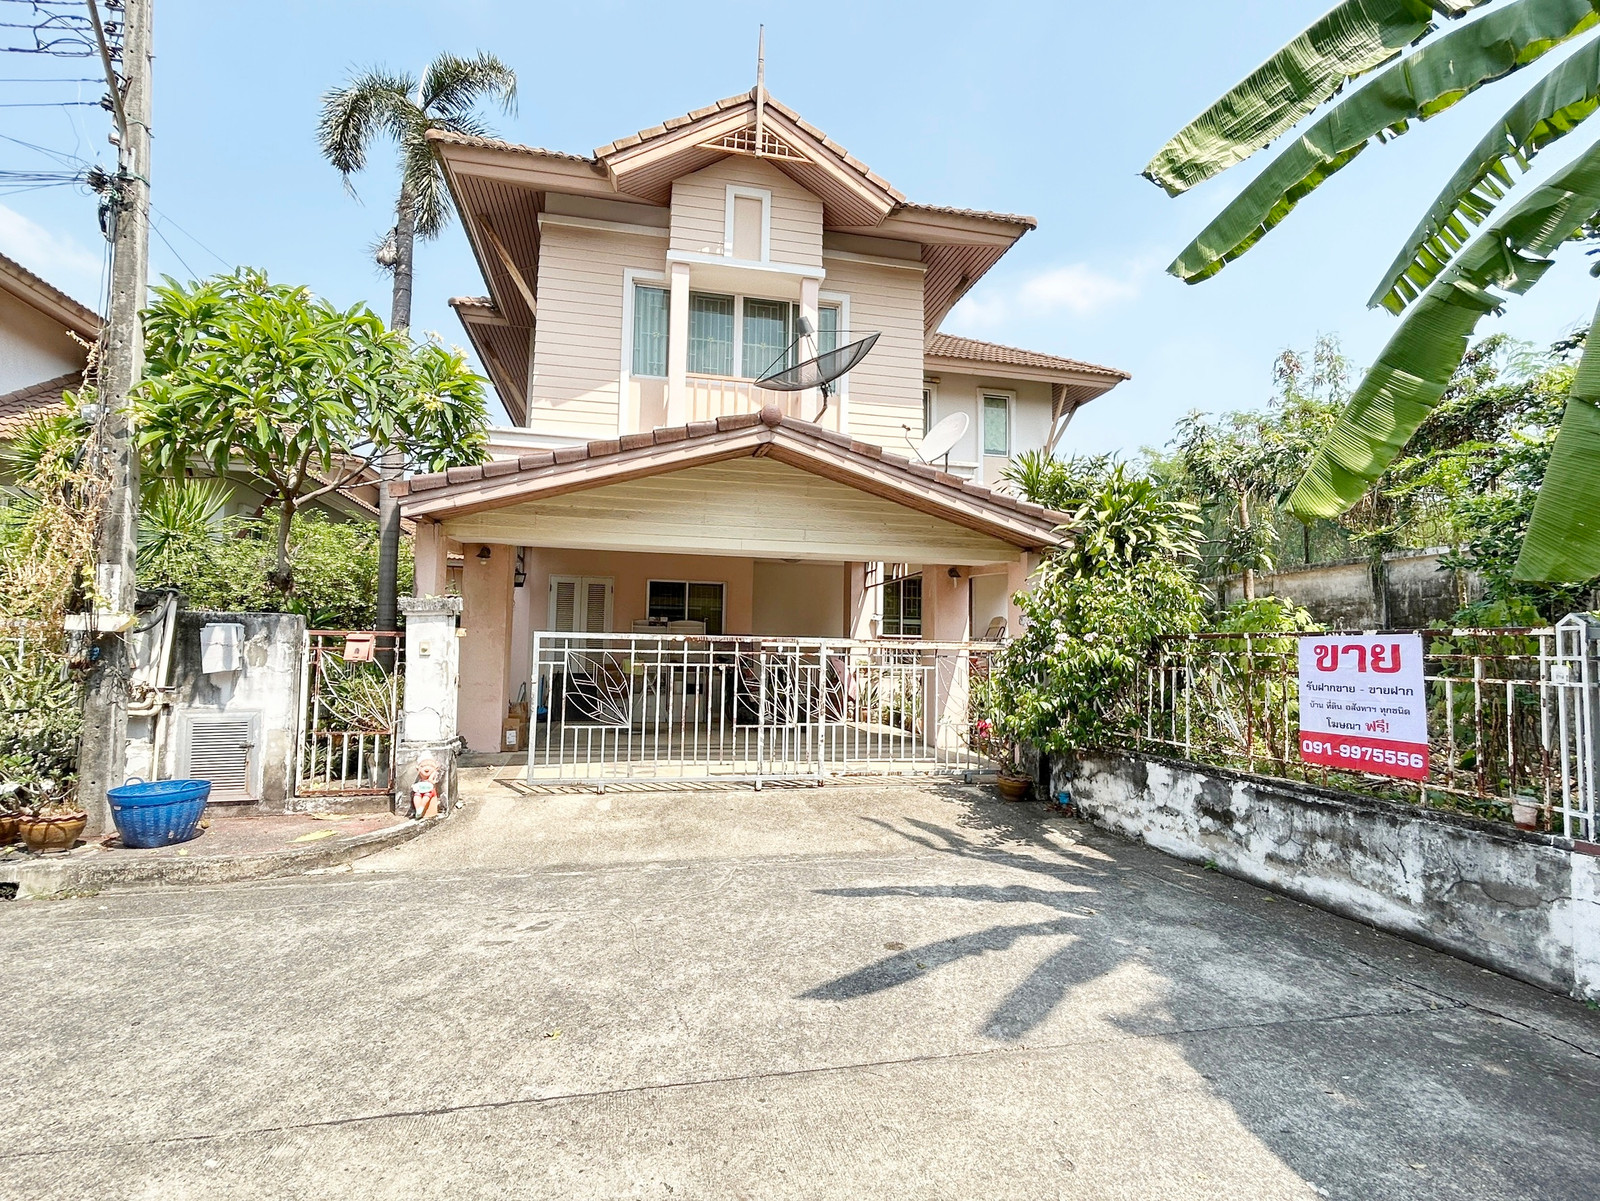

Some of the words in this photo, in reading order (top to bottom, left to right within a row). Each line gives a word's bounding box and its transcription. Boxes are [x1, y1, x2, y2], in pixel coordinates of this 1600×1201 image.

[1313, 643, 1402, 674] ขาย
[1306, 680, 1356, 693] รับฝากขาย
[1368, 685, 1414, 696] ขายฝาก
[1309, 700, 1324, 709] บ้าน
[1326, 699, 1342, 710] ที่ดิน
[1379, 705, 1411, 716] ทุกชนิด
[1326, 717, 1361, 730] โฆษณา
[1365, 719, 1389, 733] ฟรี!
[1302, 739, 1424, 768] 091-9975556
